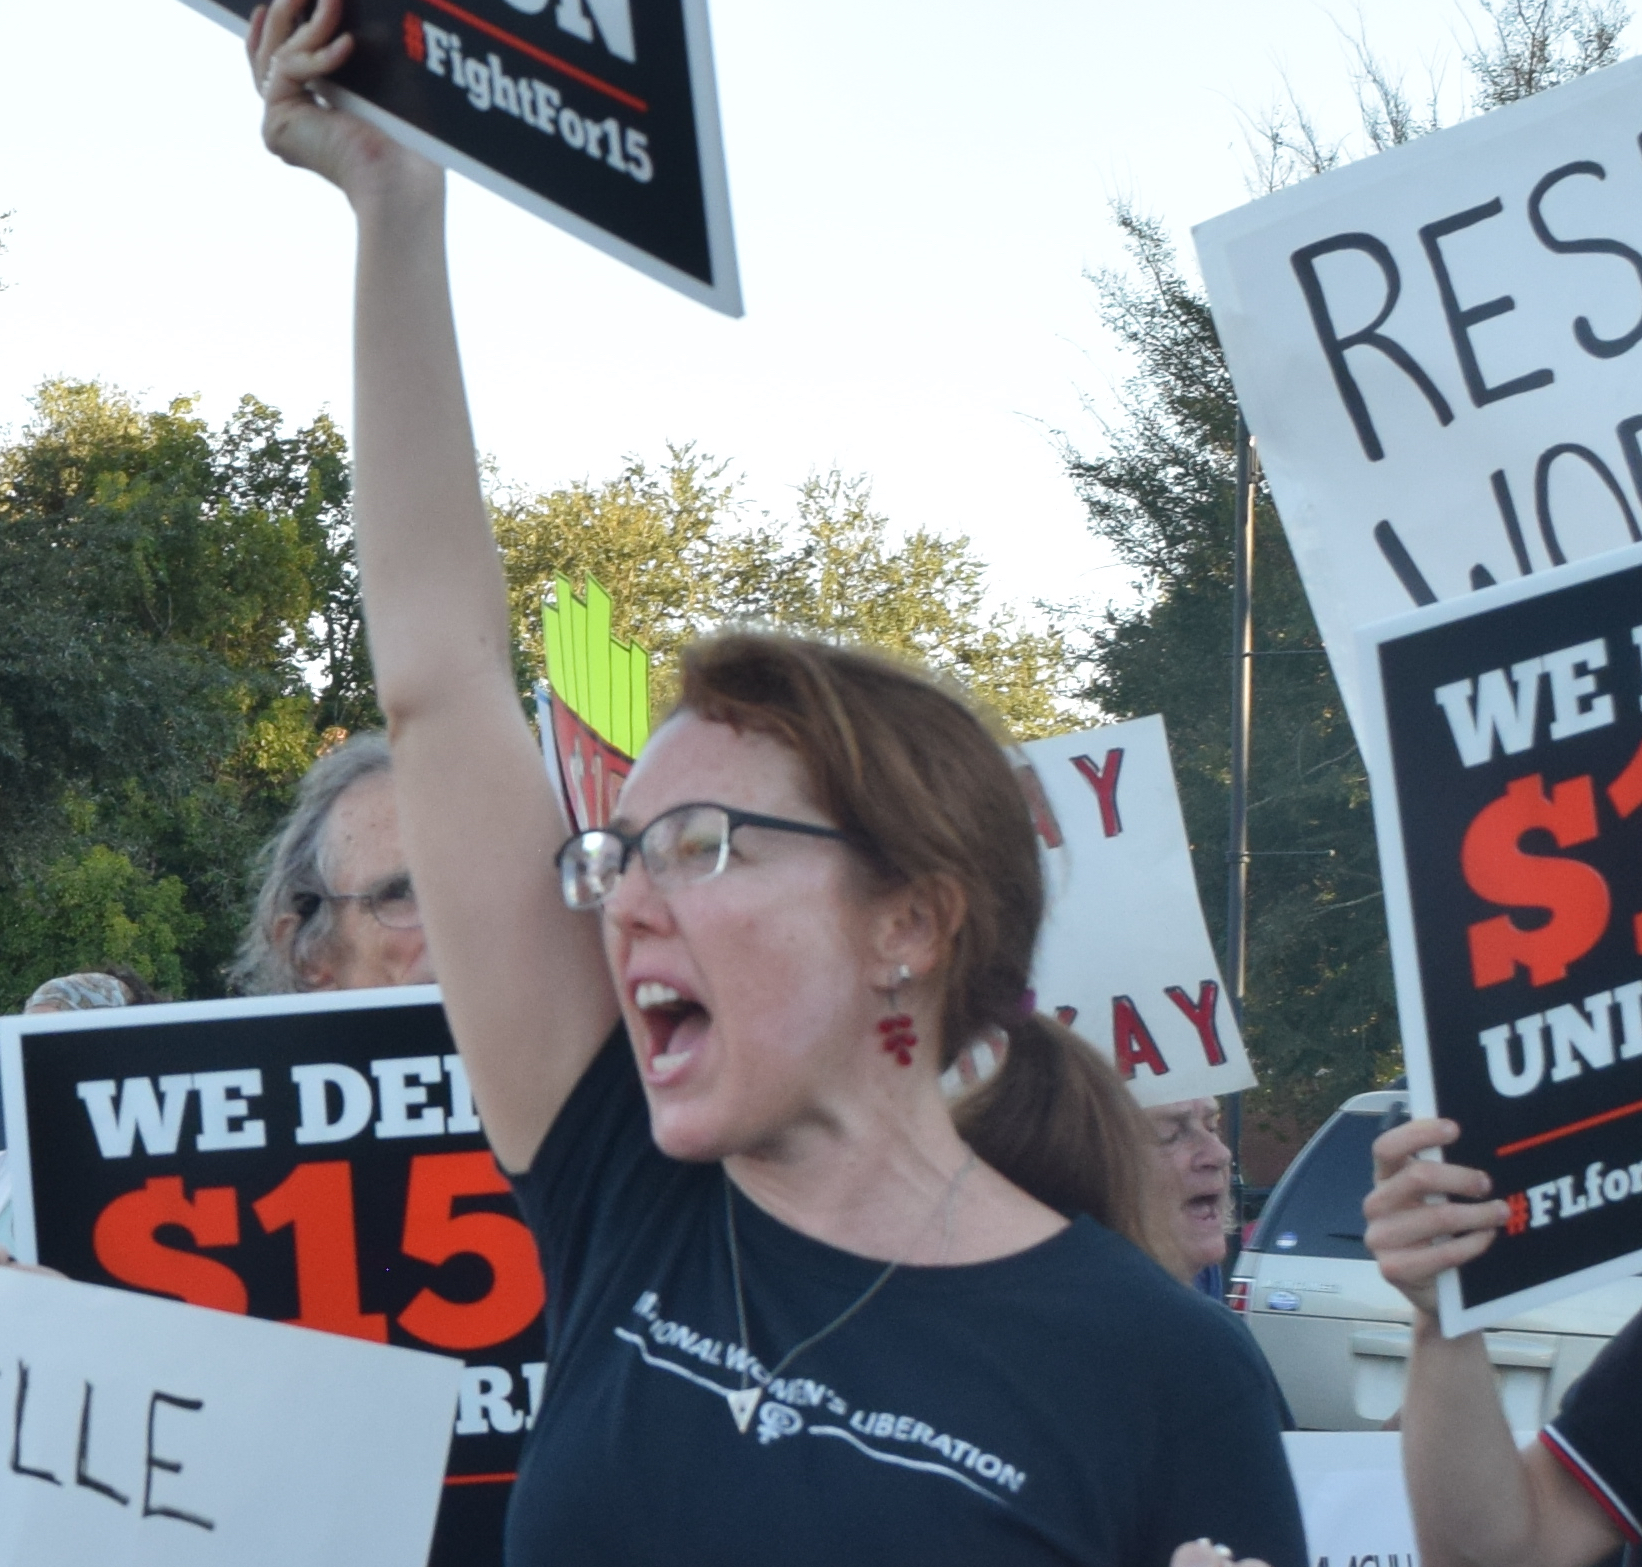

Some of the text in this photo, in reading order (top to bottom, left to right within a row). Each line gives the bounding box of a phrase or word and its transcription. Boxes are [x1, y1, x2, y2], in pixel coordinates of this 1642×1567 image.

[402, 10, 653, 183] #FightFor15
[1290, 130, 1642, 463] RES
[1435, 637, 1615, 769] WE
[76, 1053, 483, 1160] WE DE
[92, 1150, 547, 1351] $15
[848, 1408, 1027, 1493] LIBERATION
